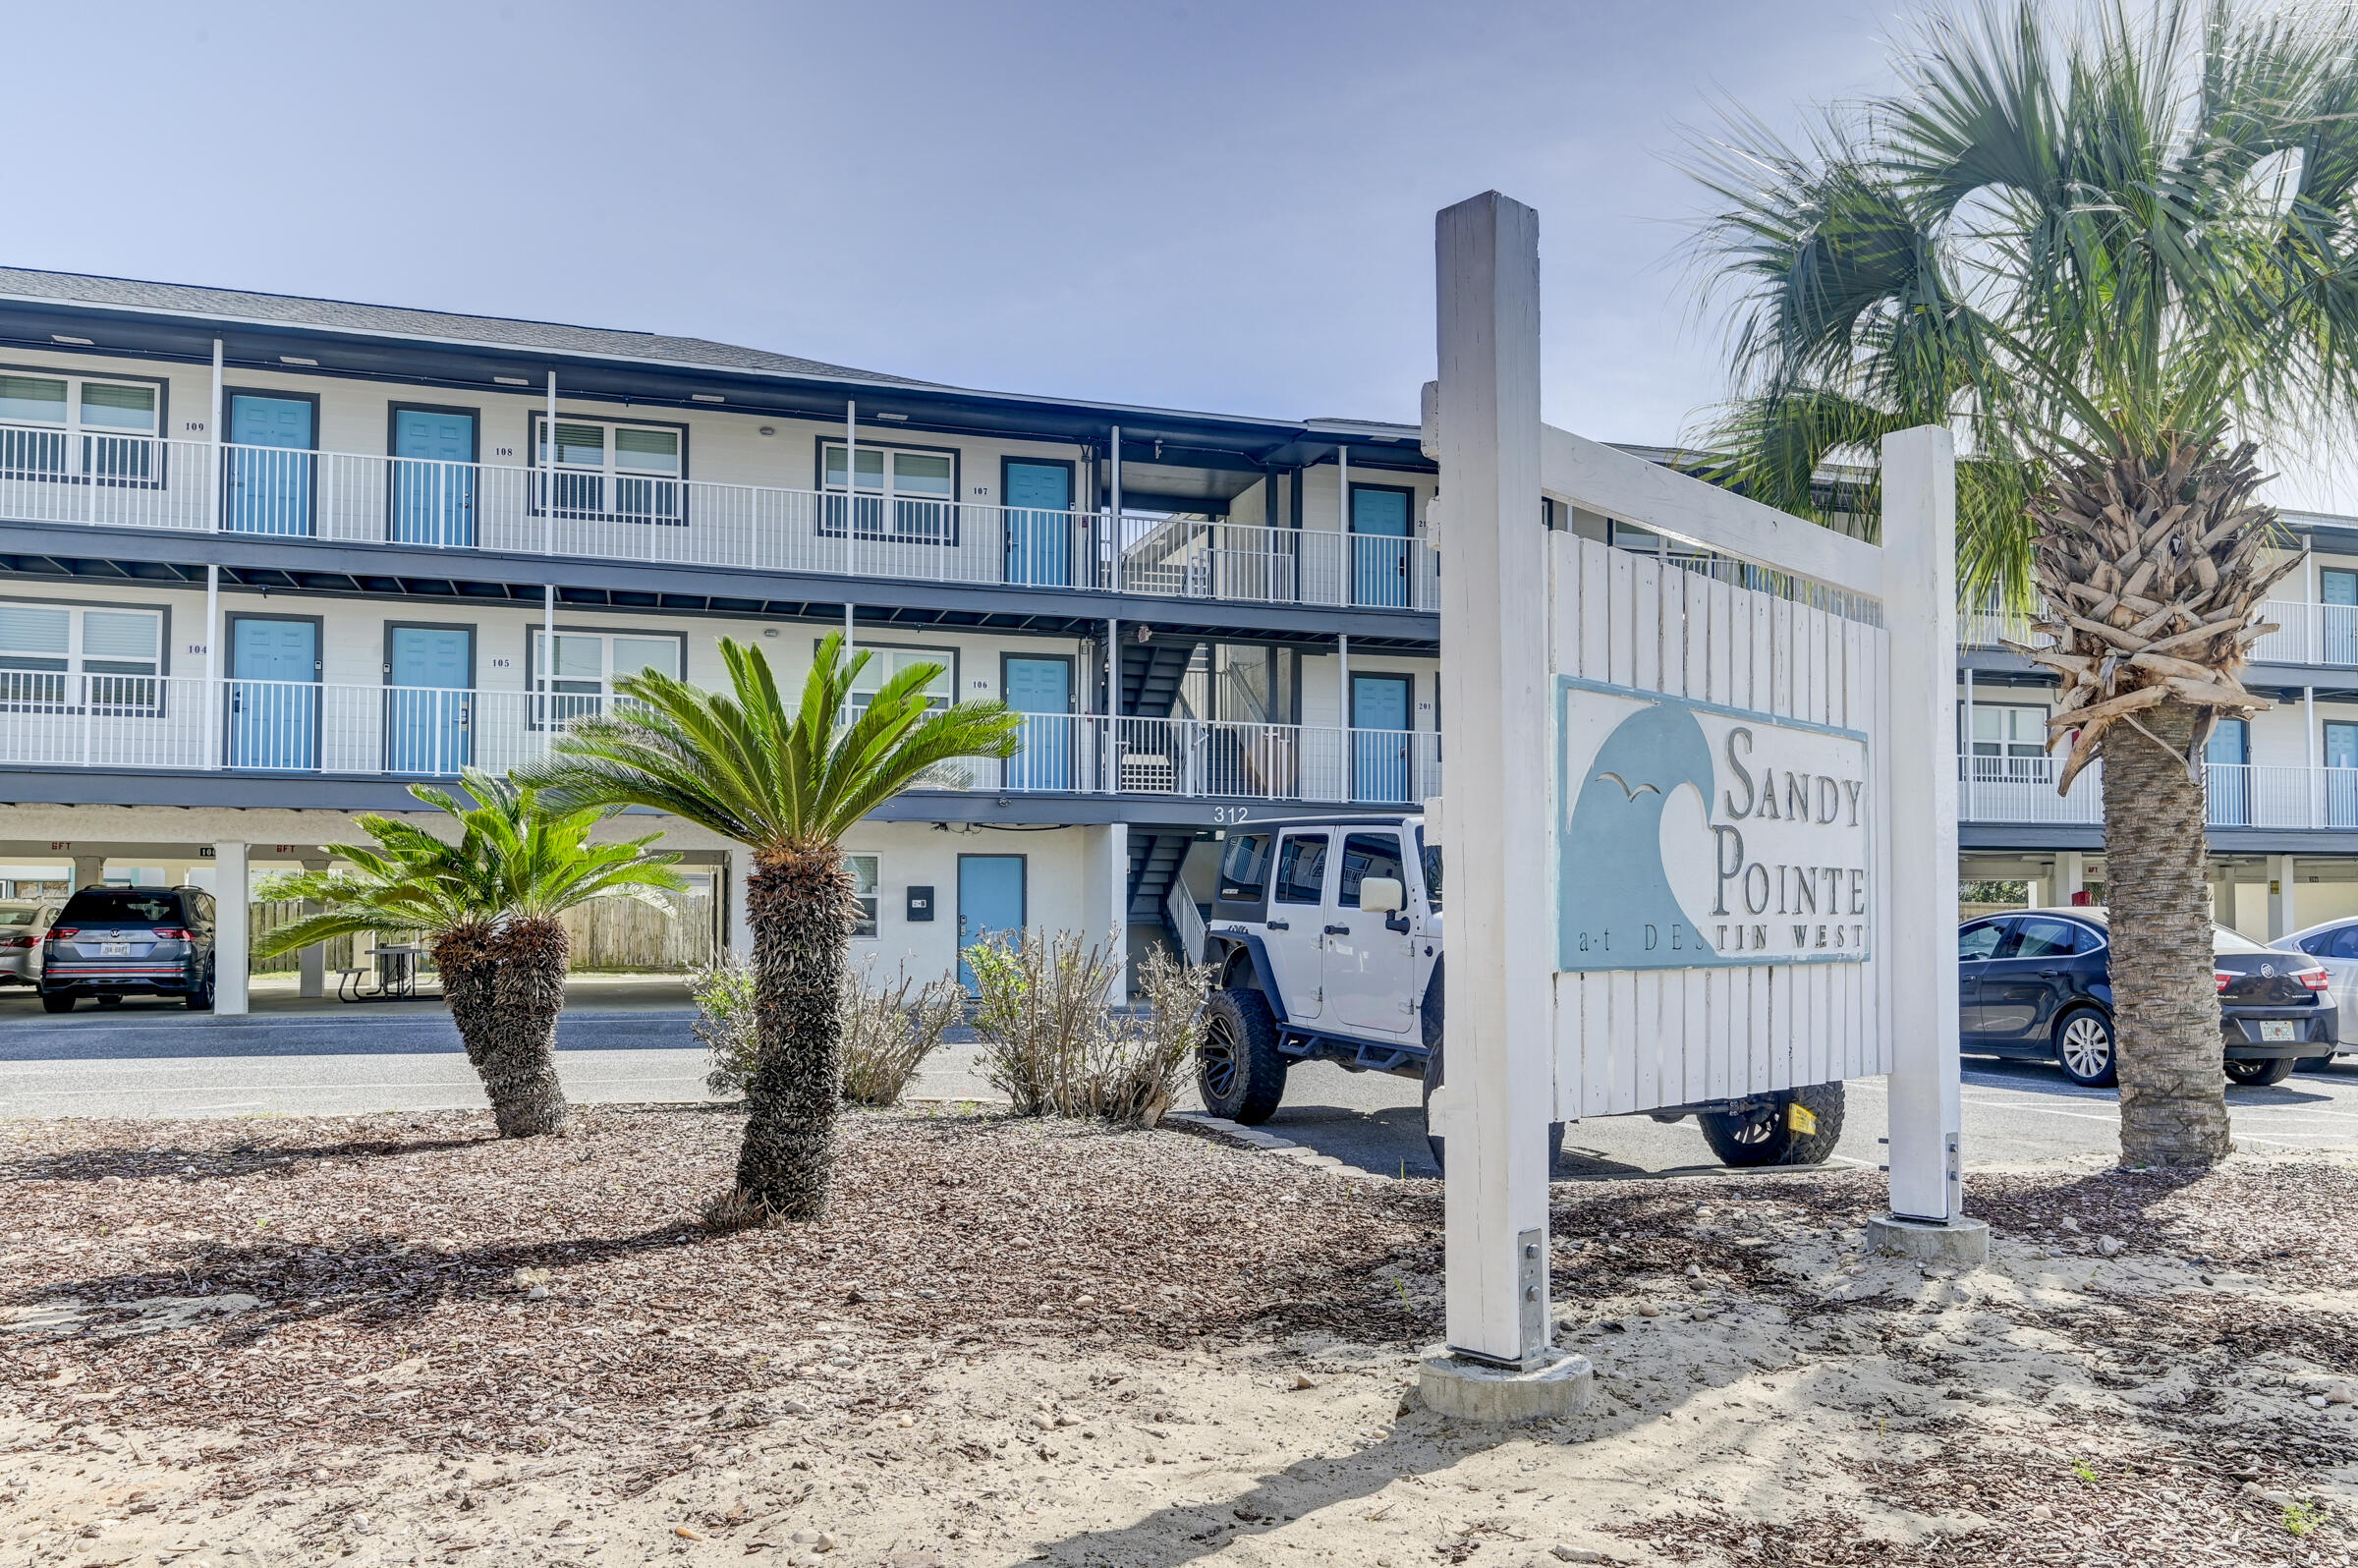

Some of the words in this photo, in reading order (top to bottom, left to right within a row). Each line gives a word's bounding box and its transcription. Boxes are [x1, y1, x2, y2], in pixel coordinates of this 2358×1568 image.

[186, 422, 204, 431] 109
[496, 447, 513, 457] 108
[189, 644, 207, 654] 104
[492, 658, 510, 668] 105
[1726, 726, 1863, 827] SANDY
[1213, 806, 1249, 823] 312
[1711, 824, 1865, 916] POINTE
[1644, 924, 1768, 951] DESTIN
[1792, 924, 1863, 948] WEST
